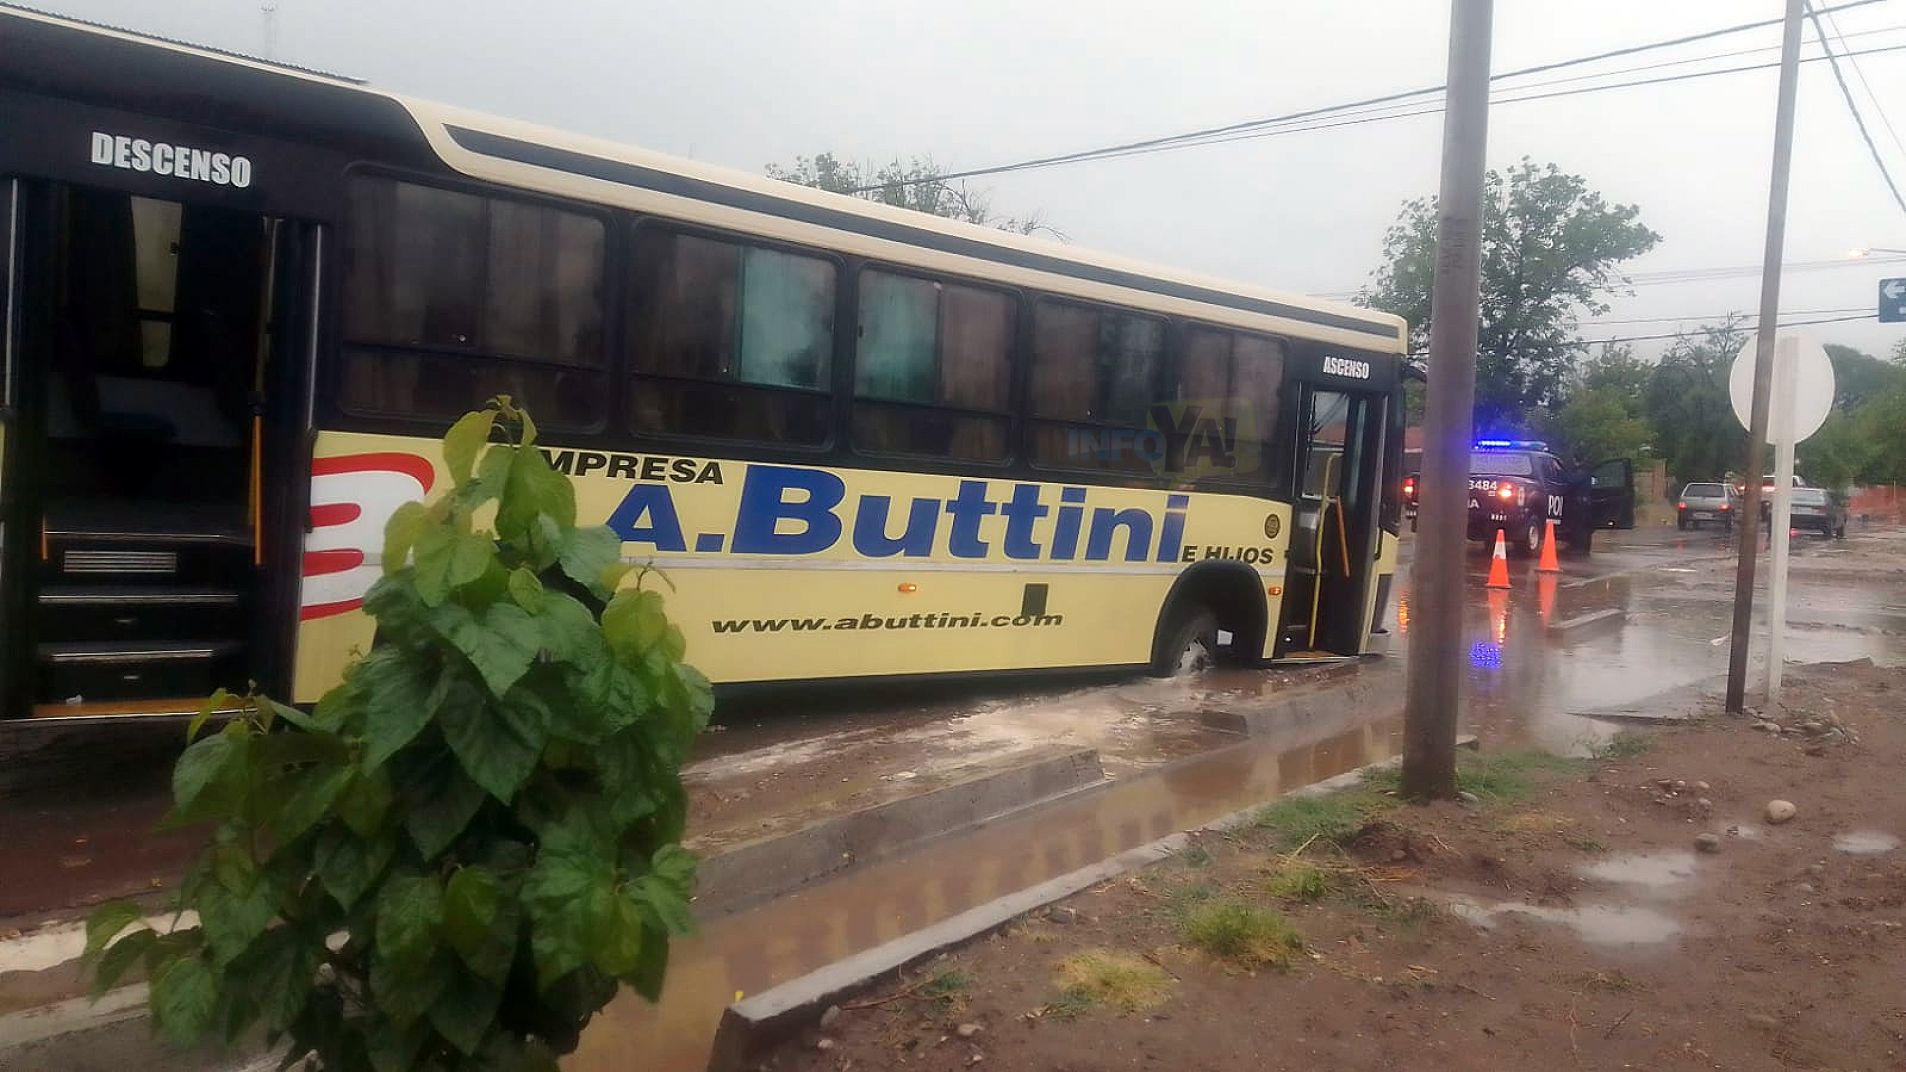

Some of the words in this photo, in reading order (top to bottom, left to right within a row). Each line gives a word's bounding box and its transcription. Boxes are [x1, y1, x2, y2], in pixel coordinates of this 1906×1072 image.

[91, 131, 252, 188] DESCENSO
[1322, 355, 1370, 380] ASCENSO
[540, 449, 724, 485] MPRESA
[1181, 545, 1198, 563] E
[1204, 545, 1274, 565] HIJOS
[712, 611, 1063, 634] www.abuttini.com
